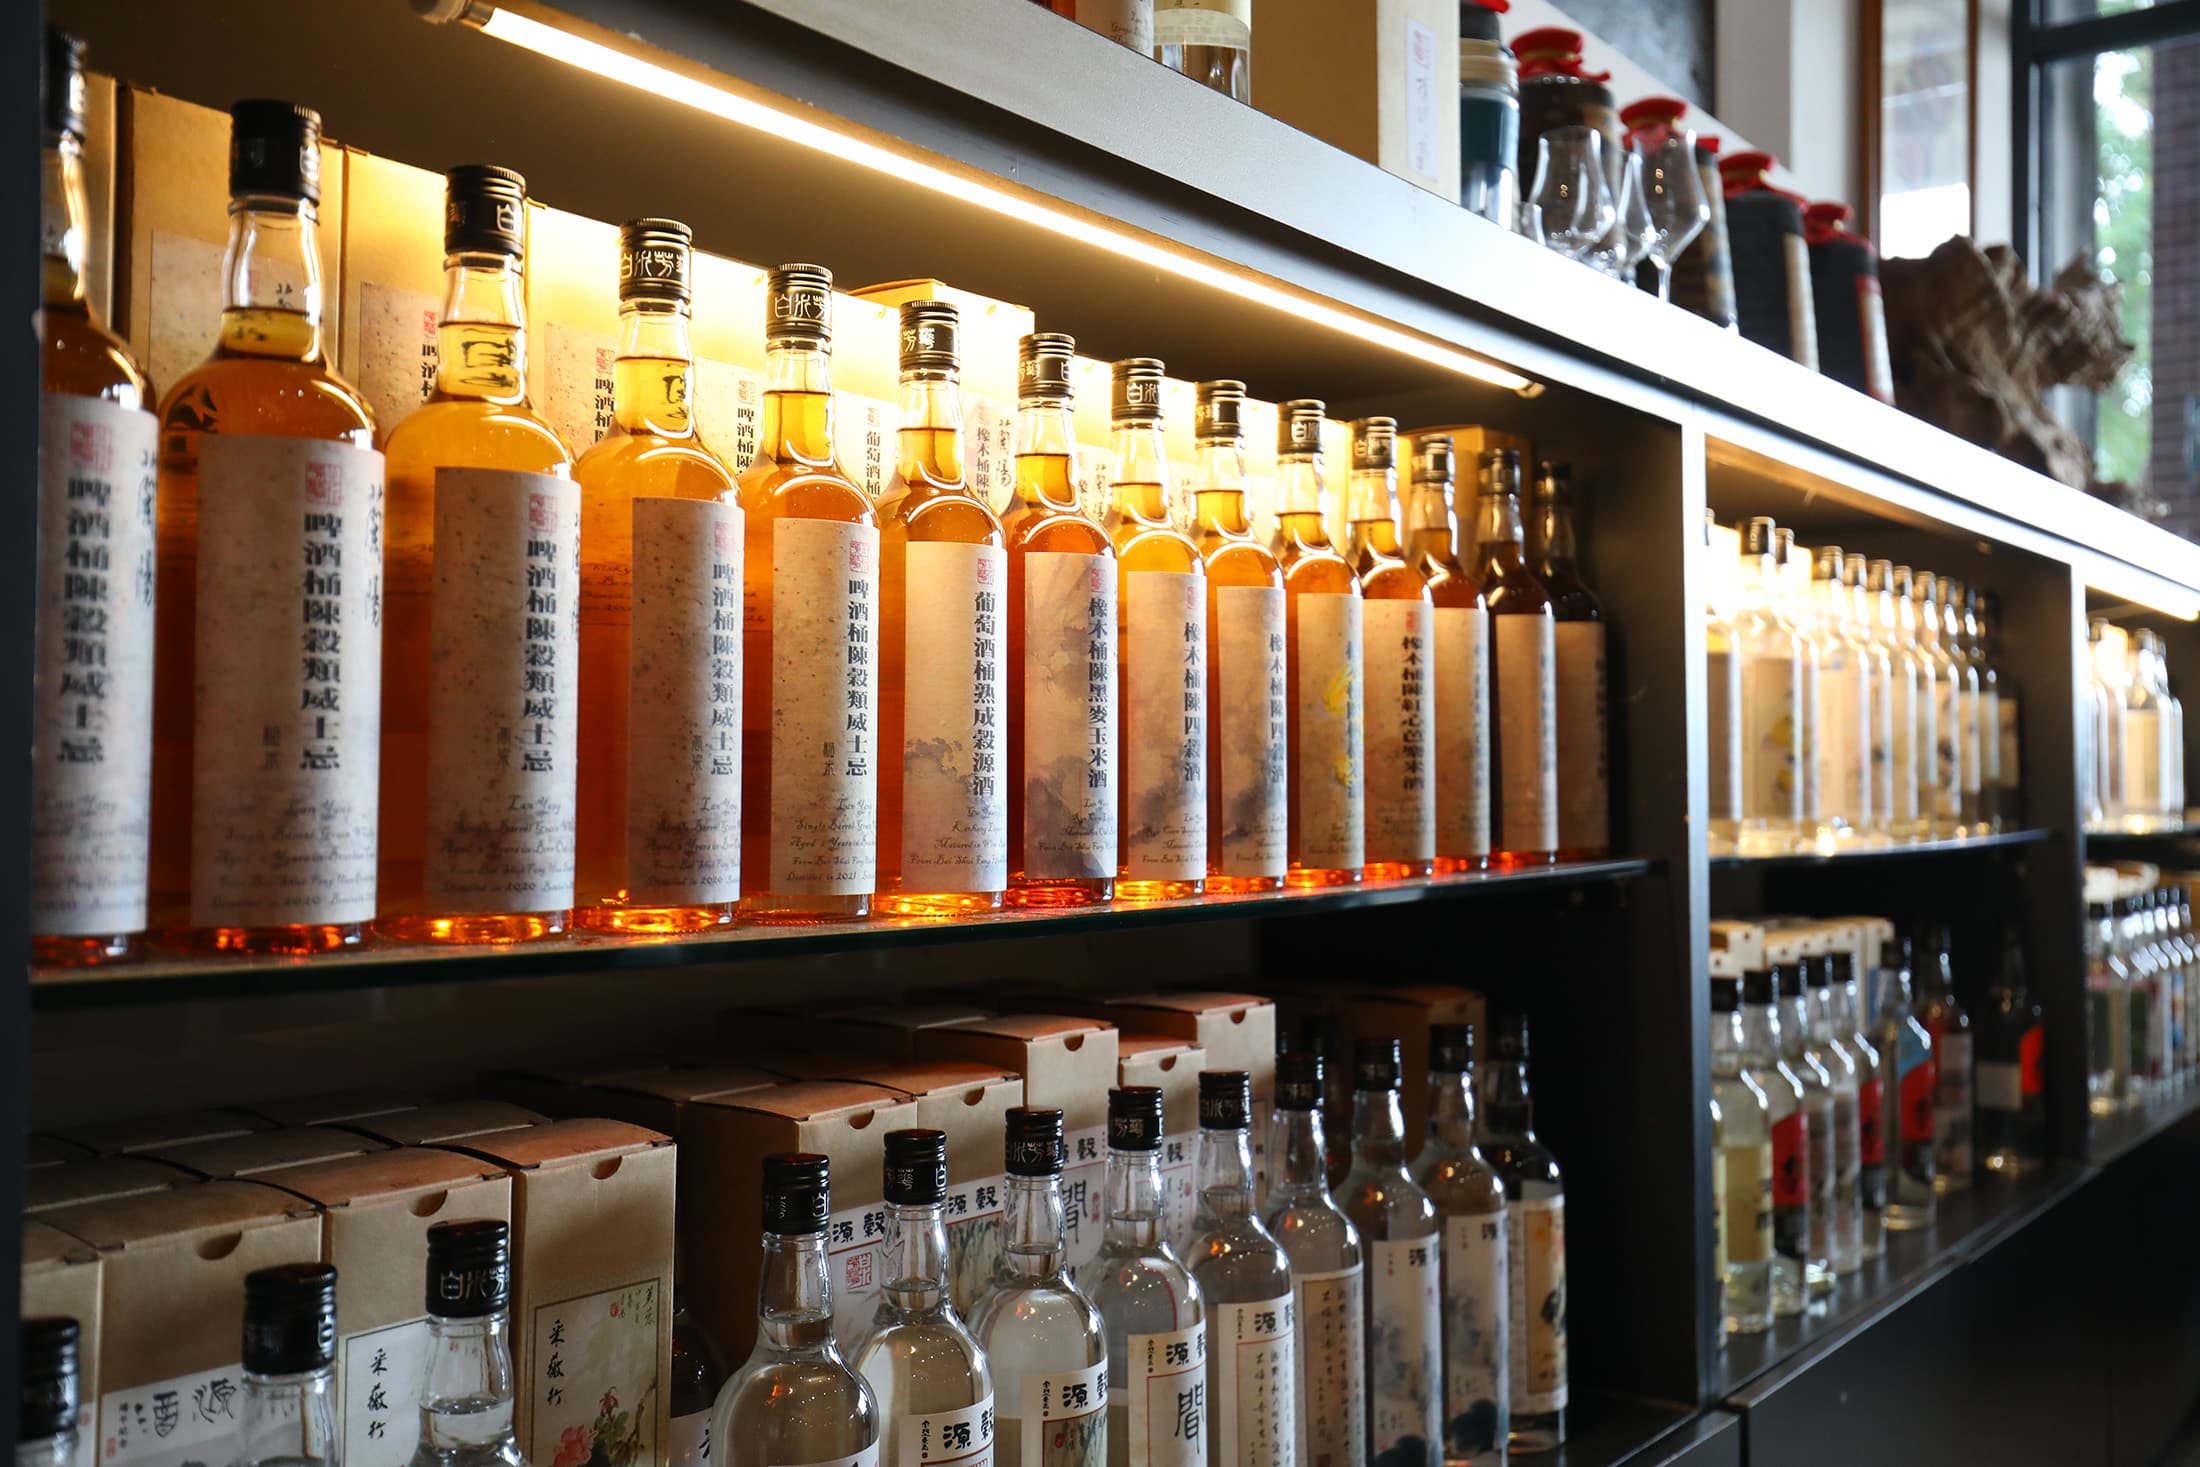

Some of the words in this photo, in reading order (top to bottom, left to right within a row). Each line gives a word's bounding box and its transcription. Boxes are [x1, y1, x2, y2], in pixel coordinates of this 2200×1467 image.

[56, 476, 113, 766] 啤酒桶陳穀類威士忌
[299, 511, 342, 771] 啤酒桶陳穀類威士忌
[520, 537, 558, 774] 啤酒桶陳穀類威士忌
[709, 561, 735, 777] 啤酒桶陳穀類威士忌
[846, 578, 871, 778] 啤酒桶陳穀類威士忌
[971, 591, 997, 797] 葡萄酒桶熟成穀源酒
[1088, 597, 1109, 789] 橡木桶陳黑麥玉米酒
[1184, 621, 1202, 783] 橡木桶陳四穀酒
